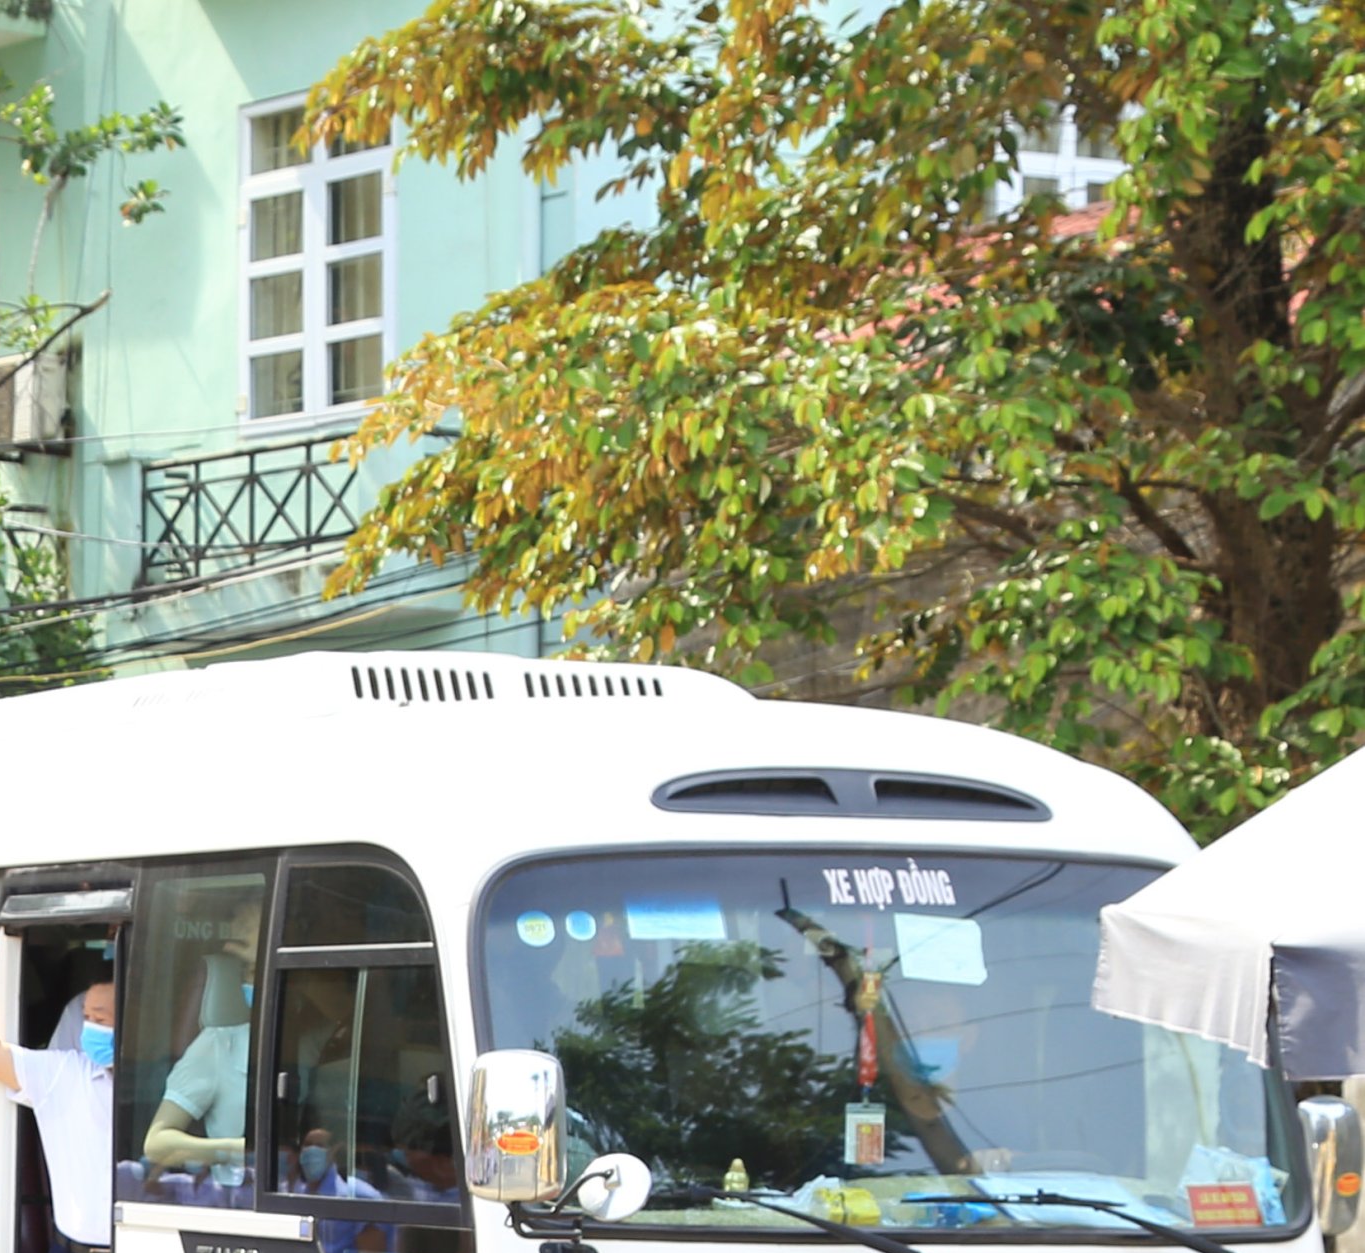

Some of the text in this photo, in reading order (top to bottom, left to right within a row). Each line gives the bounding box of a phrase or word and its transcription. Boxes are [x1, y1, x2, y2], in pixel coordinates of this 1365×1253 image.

[822, 857, 956, 911] XE HỢP ĐỒNG
